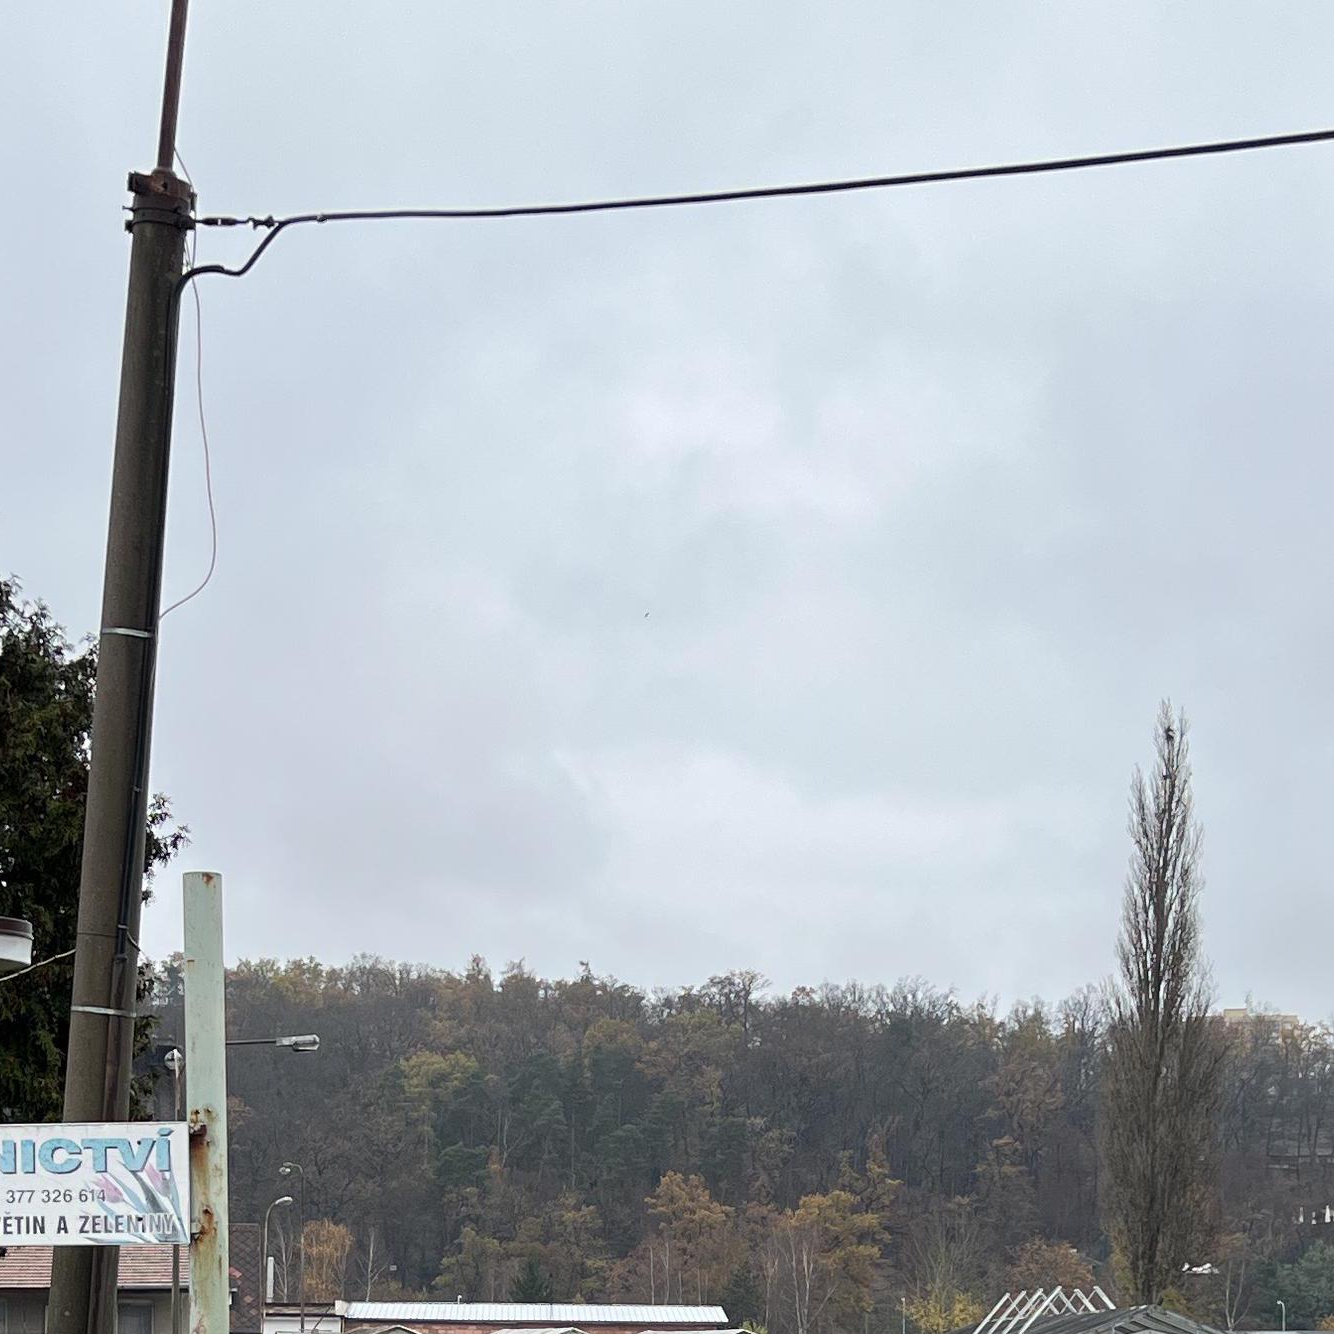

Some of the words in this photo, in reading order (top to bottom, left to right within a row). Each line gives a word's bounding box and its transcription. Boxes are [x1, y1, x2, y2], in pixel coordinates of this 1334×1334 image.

[6, 1190, 34, 1204] 377
[42, 1189, 73, 1203] 326
[79, 1188, 106, 1202] 614
[57, 1216, 69, 1234] A
[79, 1212, 174, 1234] ZELENINY
